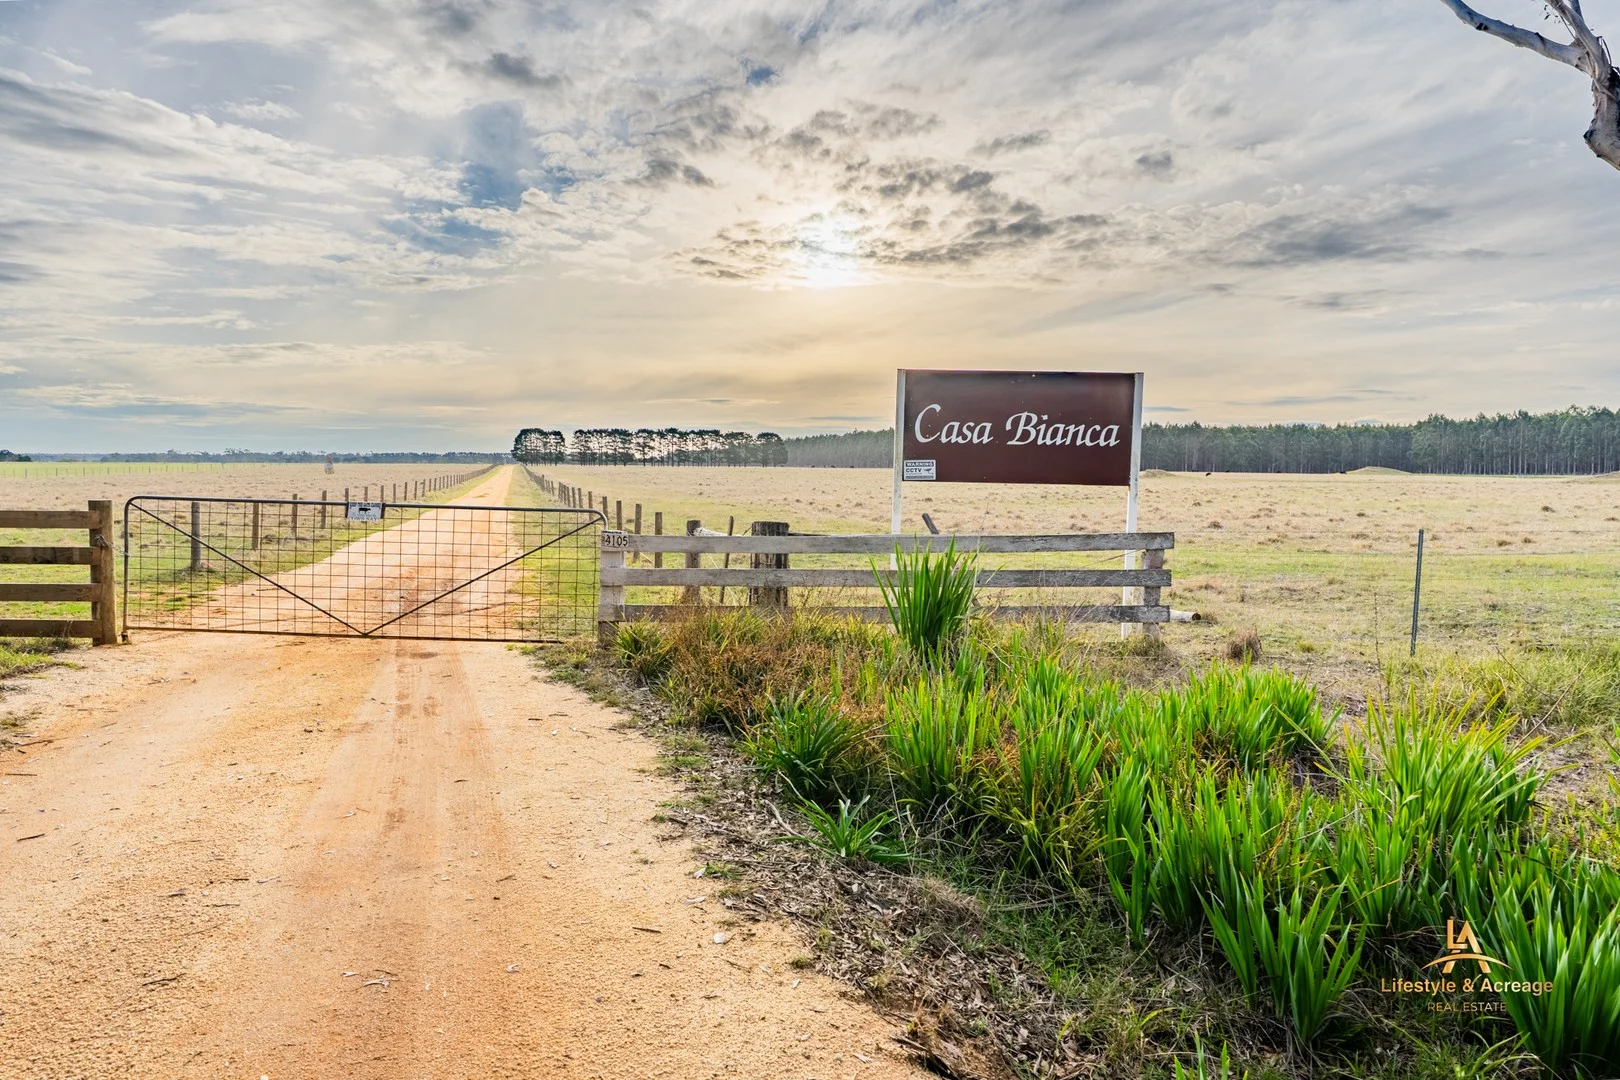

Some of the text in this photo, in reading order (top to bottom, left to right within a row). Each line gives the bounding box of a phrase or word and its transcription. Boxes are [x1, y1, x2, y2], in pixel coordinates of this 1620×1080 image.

[914, 403, 1120, 447] Casa Bianca
[605, 535, 628, 547] 4105
